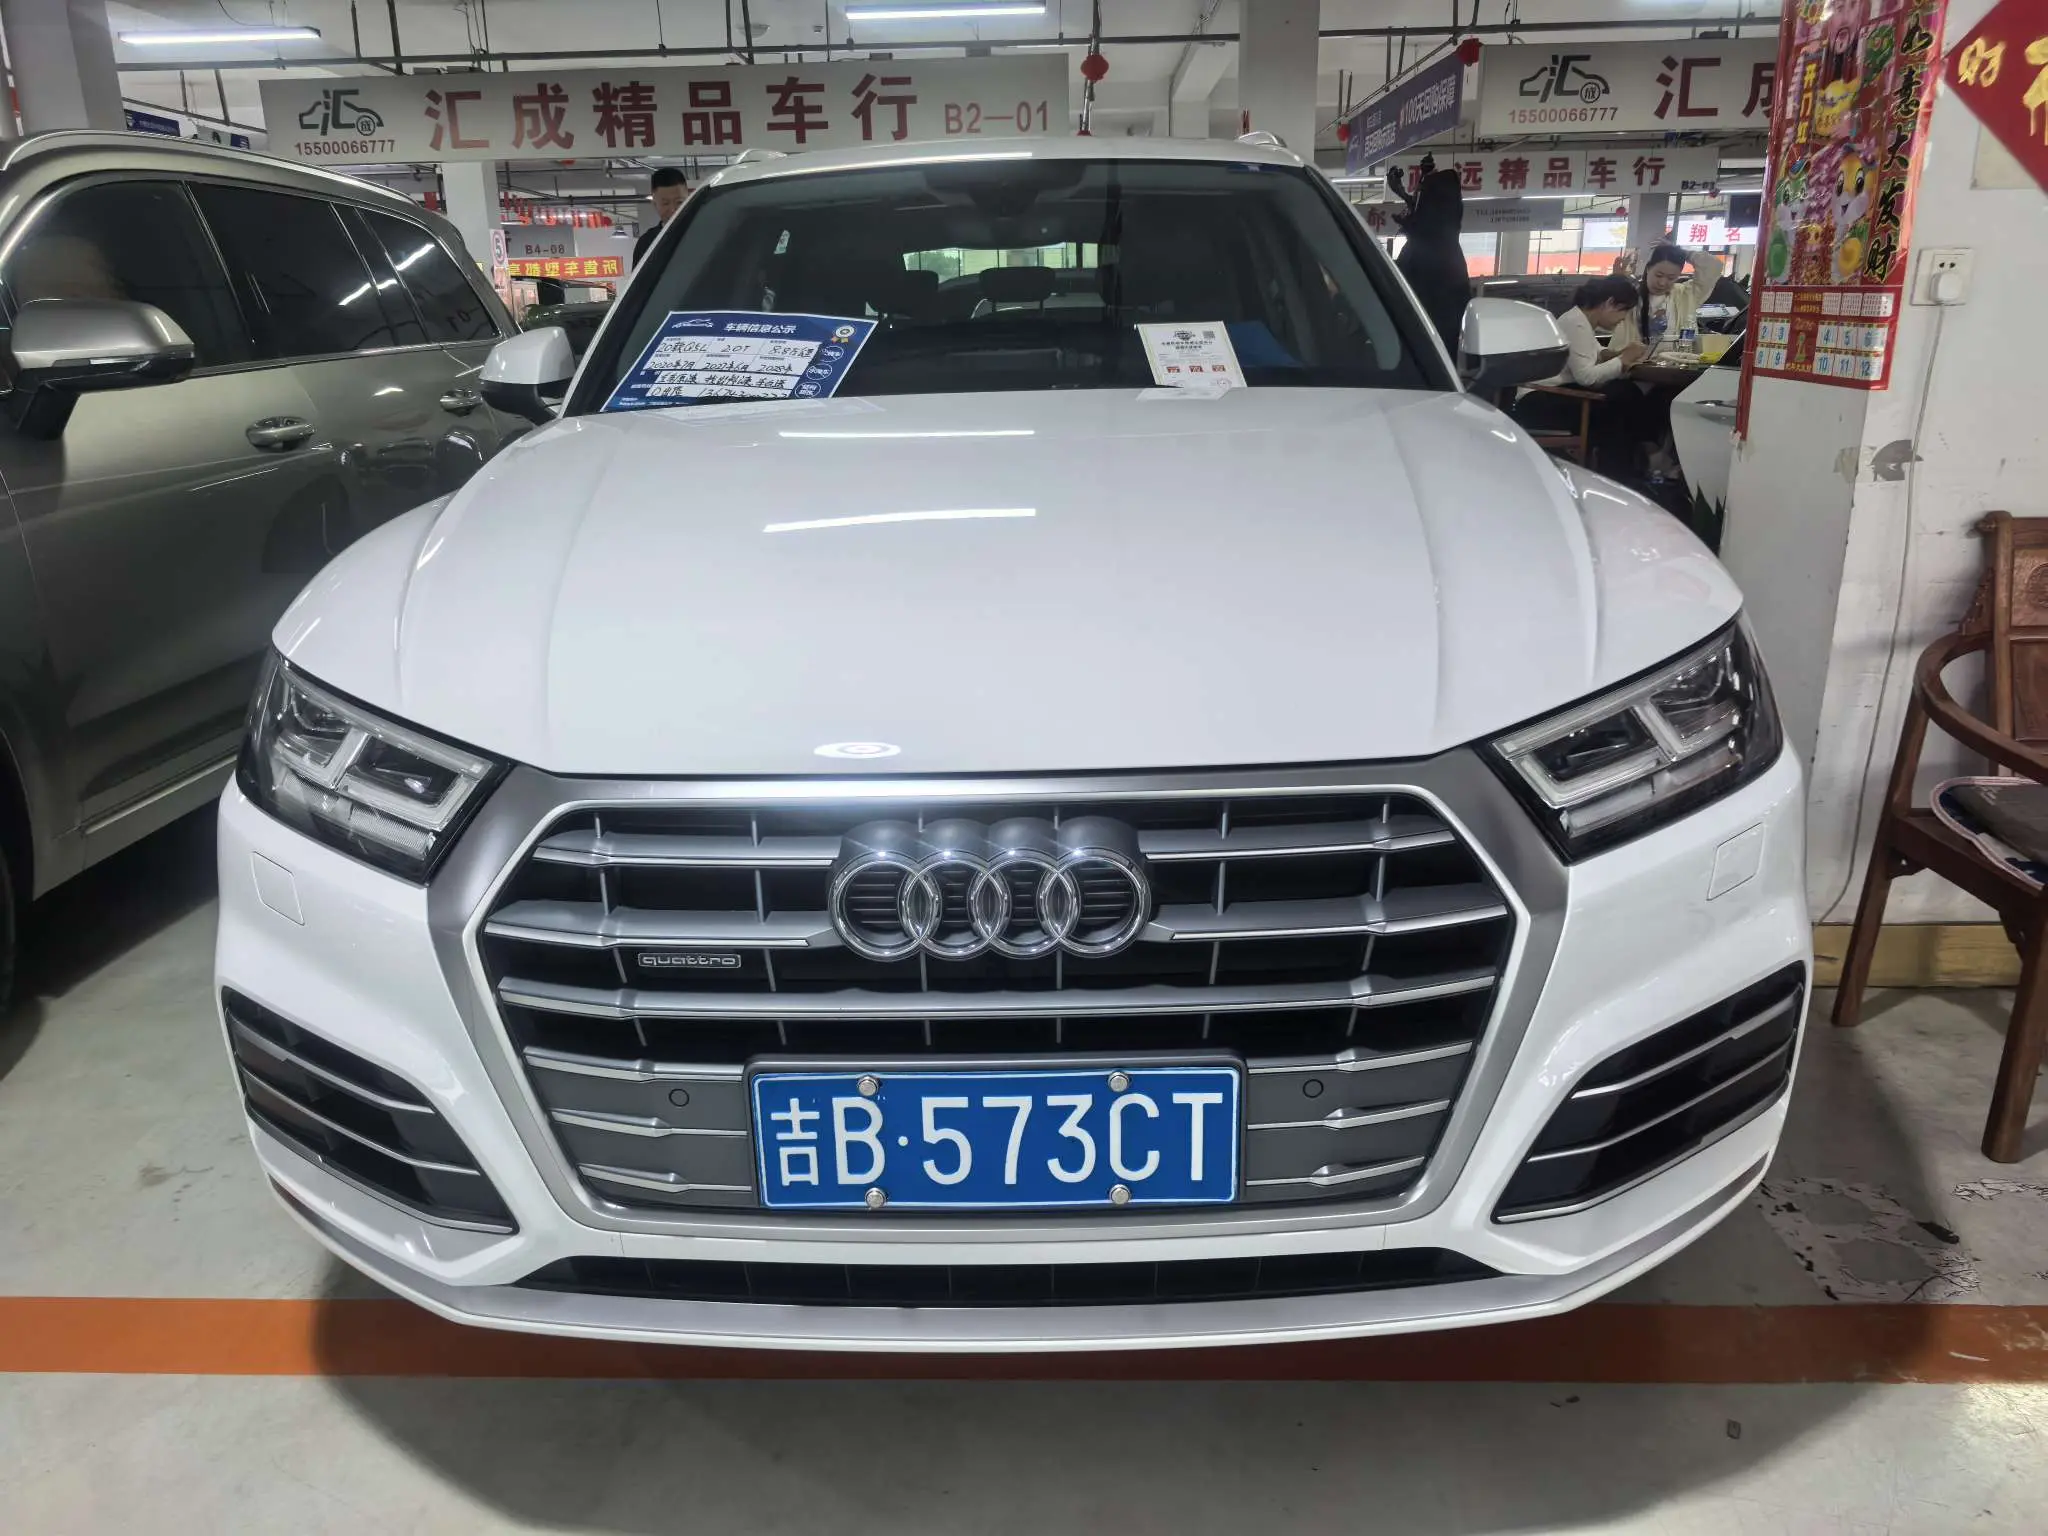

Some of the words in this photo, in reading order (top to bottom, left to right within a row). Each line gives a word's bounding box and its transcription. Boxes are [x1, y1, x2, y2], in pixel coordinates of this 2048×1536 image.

[424, 74, 918, 152] 汇成精品车行
[1508, 106, 1619, 124] 15500066777
[294, 139, 395, 156] 15500066777
[524, 243, 566, 256] B4-08
[724, 321, 798, 336] 车辆信息公示
[642, 955, 736, 967] quattro
[770, 1091, 1223, 1186] 吉B·573CT
